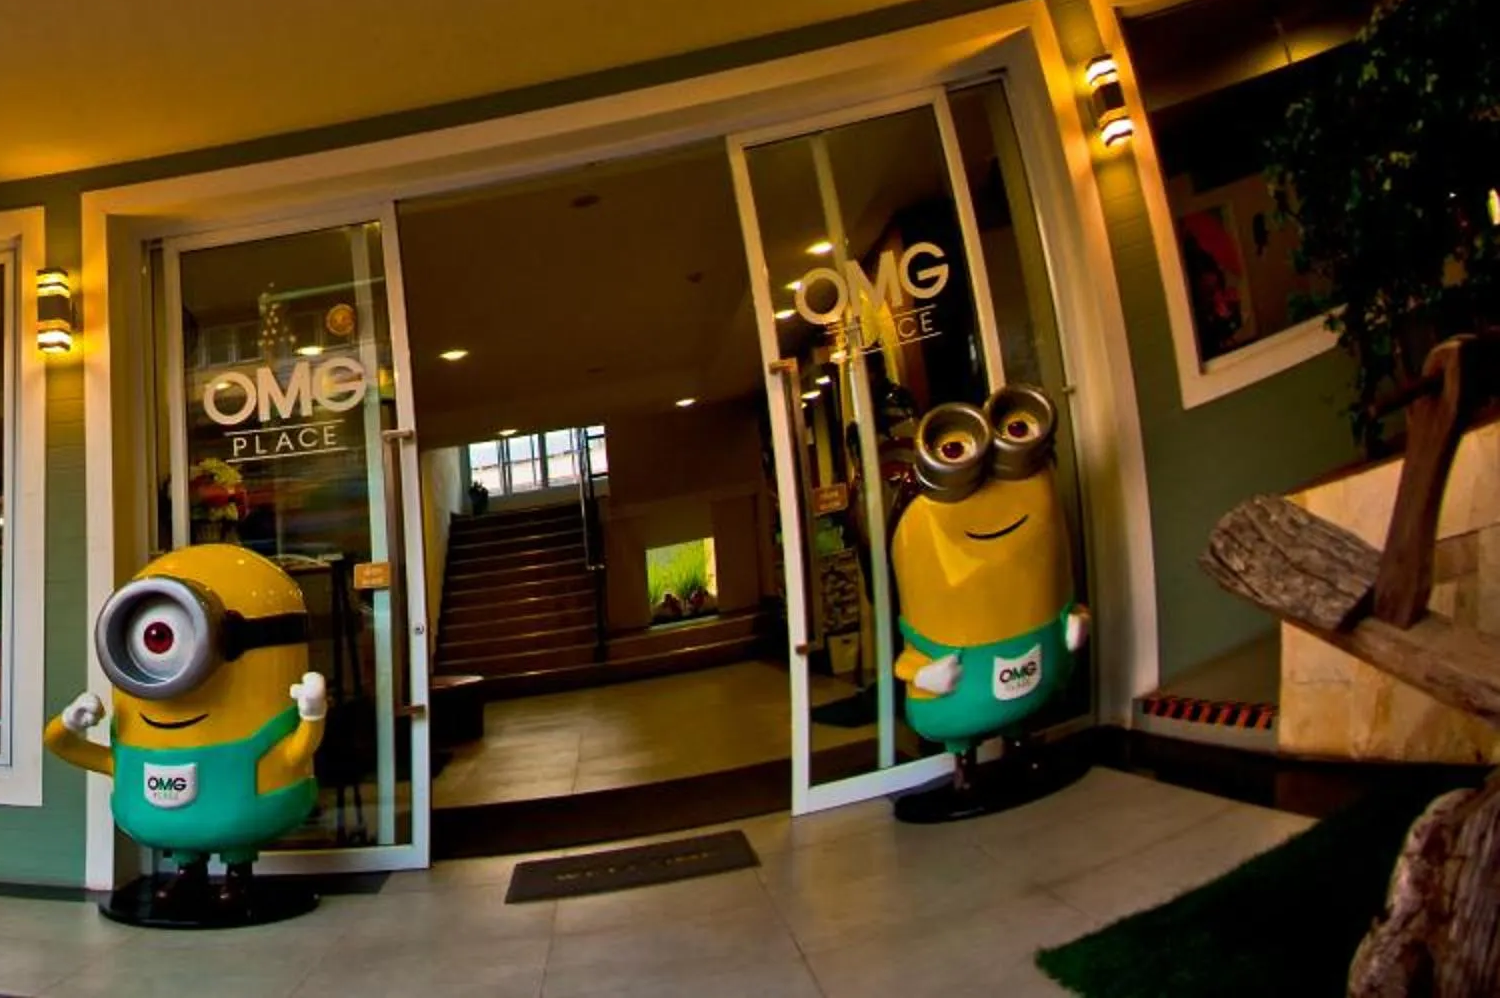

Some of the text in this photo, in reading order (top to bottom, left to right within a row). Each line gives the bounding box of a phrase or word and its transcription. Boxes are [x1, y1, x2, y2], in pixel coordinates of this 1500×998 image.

[794, 241, 949, 326] OMG
[835, 310, 934, 352] PLCE
[203, 357, 368, 426] OMG
[232, 425, 338, 457] PLACE
[999, 660, 1037, 684] OMG
[147, 776, 187, 792] OMG
